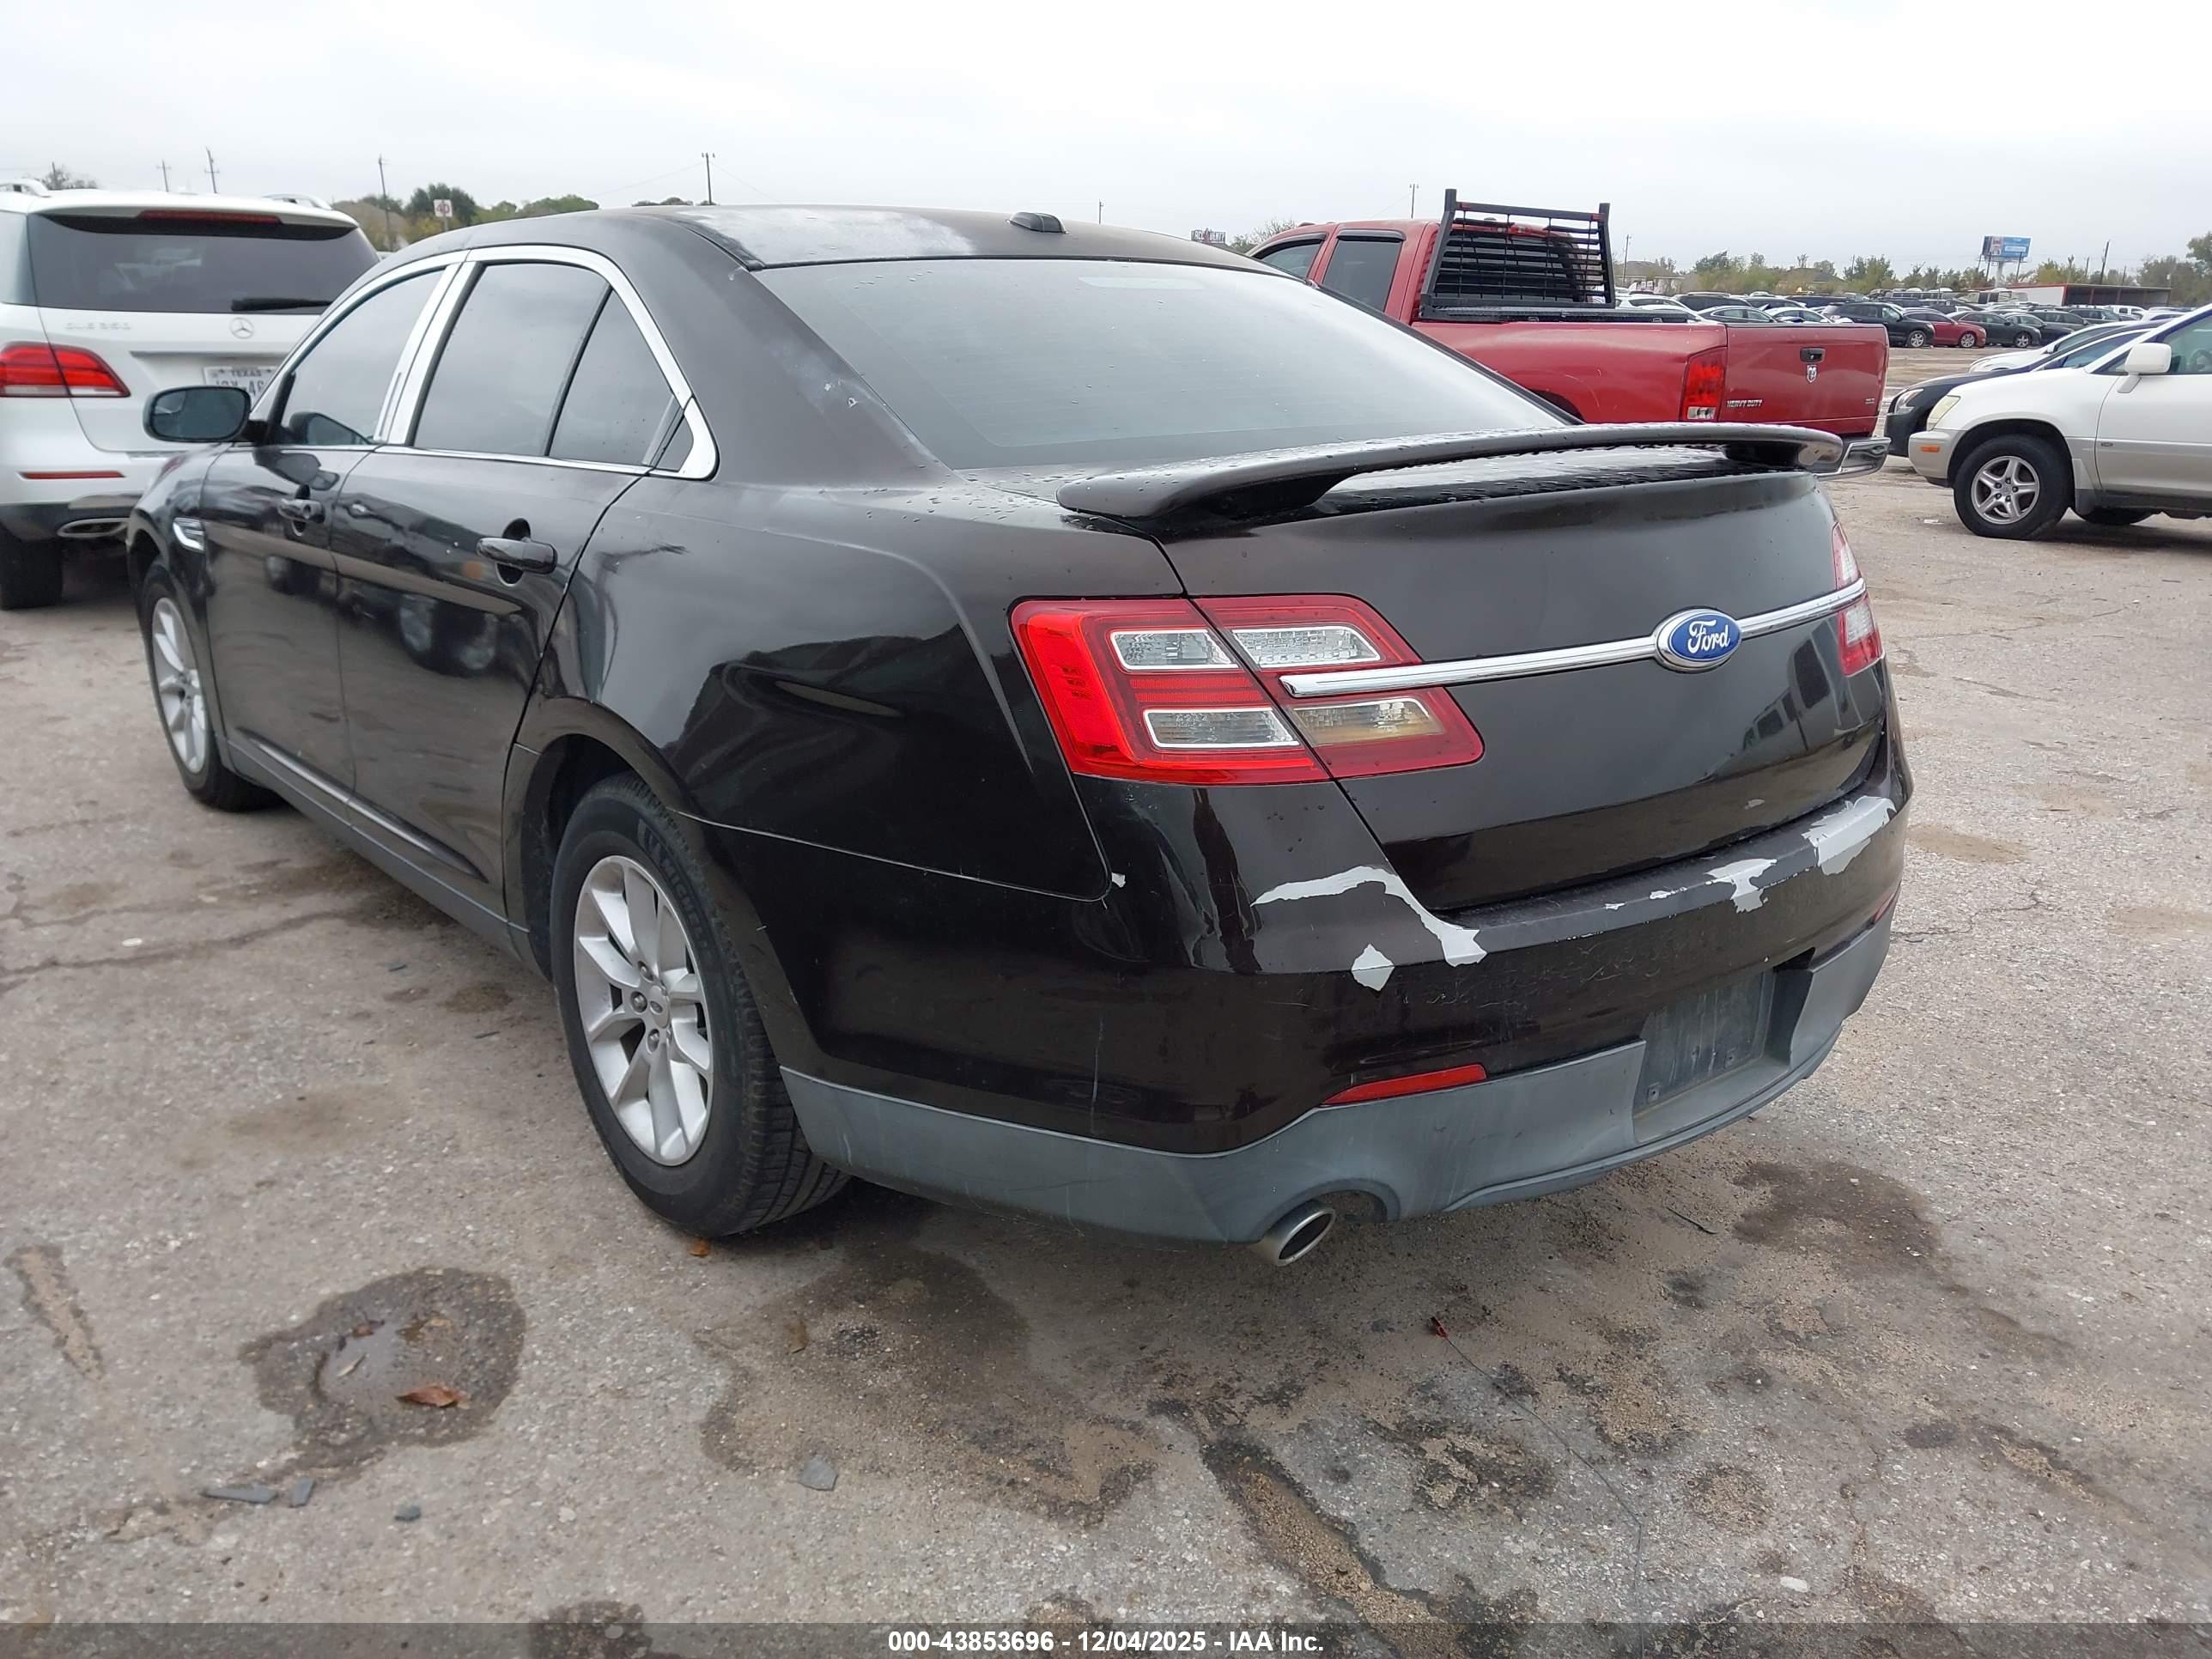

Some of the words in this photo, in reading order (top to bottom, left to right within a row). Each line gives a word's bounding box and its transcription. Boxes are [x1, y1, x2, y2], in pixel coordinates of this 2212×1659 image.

[1727, 399, 1747, 409] HEAVY
[1747, 398, 1763, 408] DUTY
[1687, 619, 1731, 653] Ford
